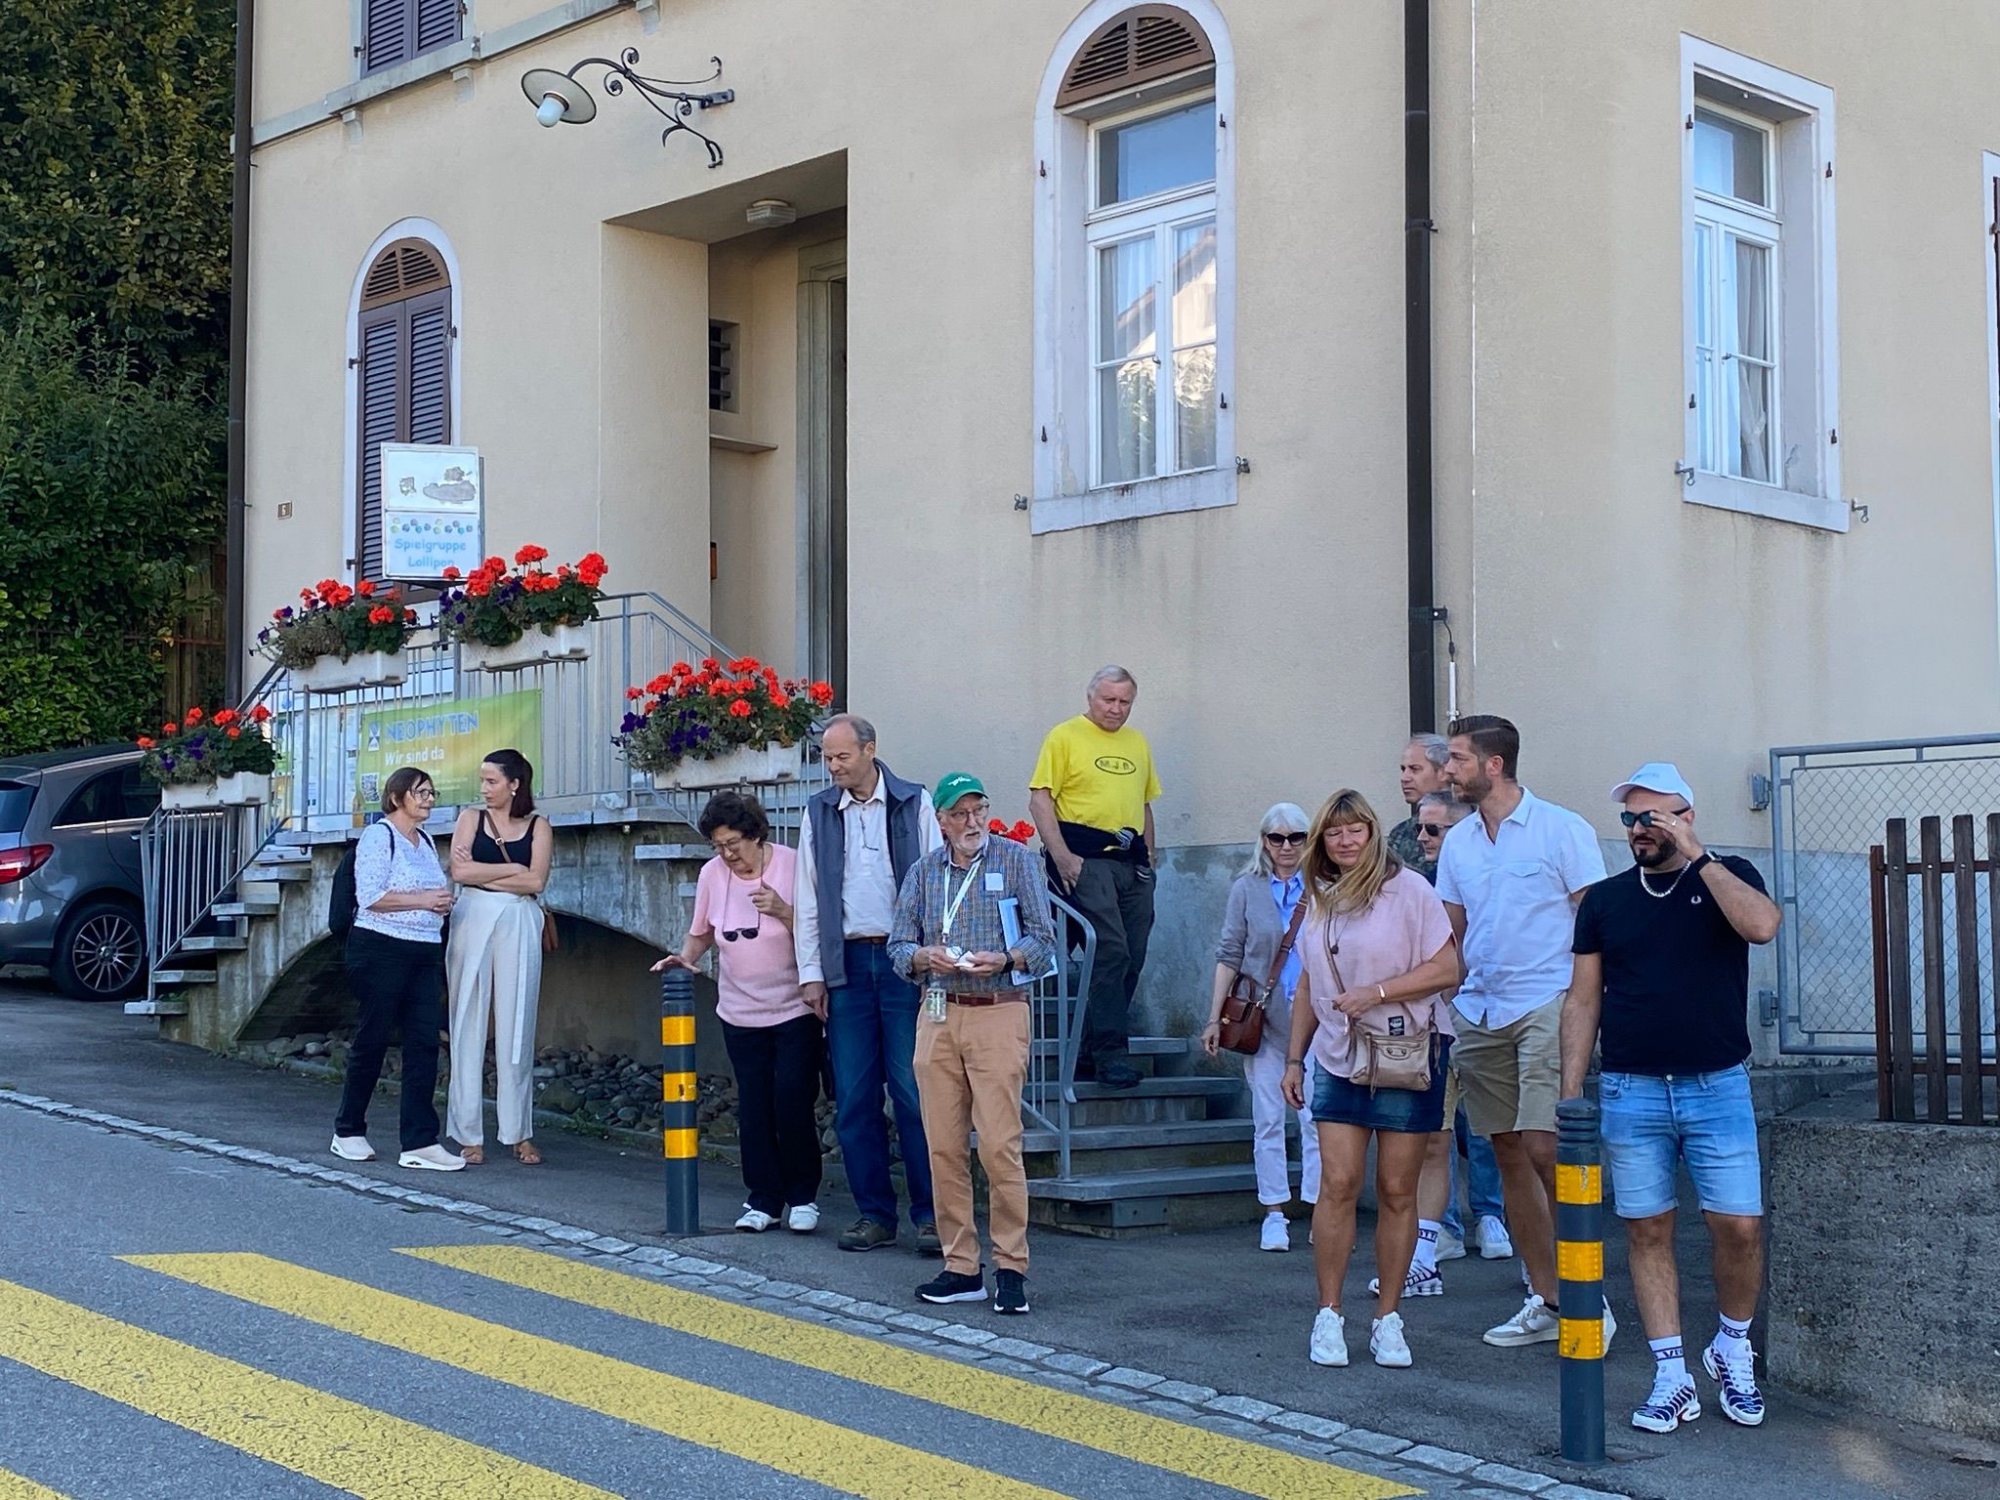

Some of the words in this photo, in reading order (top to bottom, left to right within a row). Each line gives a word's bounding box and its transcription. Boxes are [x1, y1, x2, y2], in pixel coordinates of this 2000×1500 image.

[394, 538, 467, 553] Spielgruppe
[386, 711, 479, 742] NEOPHYTEN
[384, 750, 404, 767] Wir
[406, 747, 428, 762] sind
[431, 746, 444, 760] da
